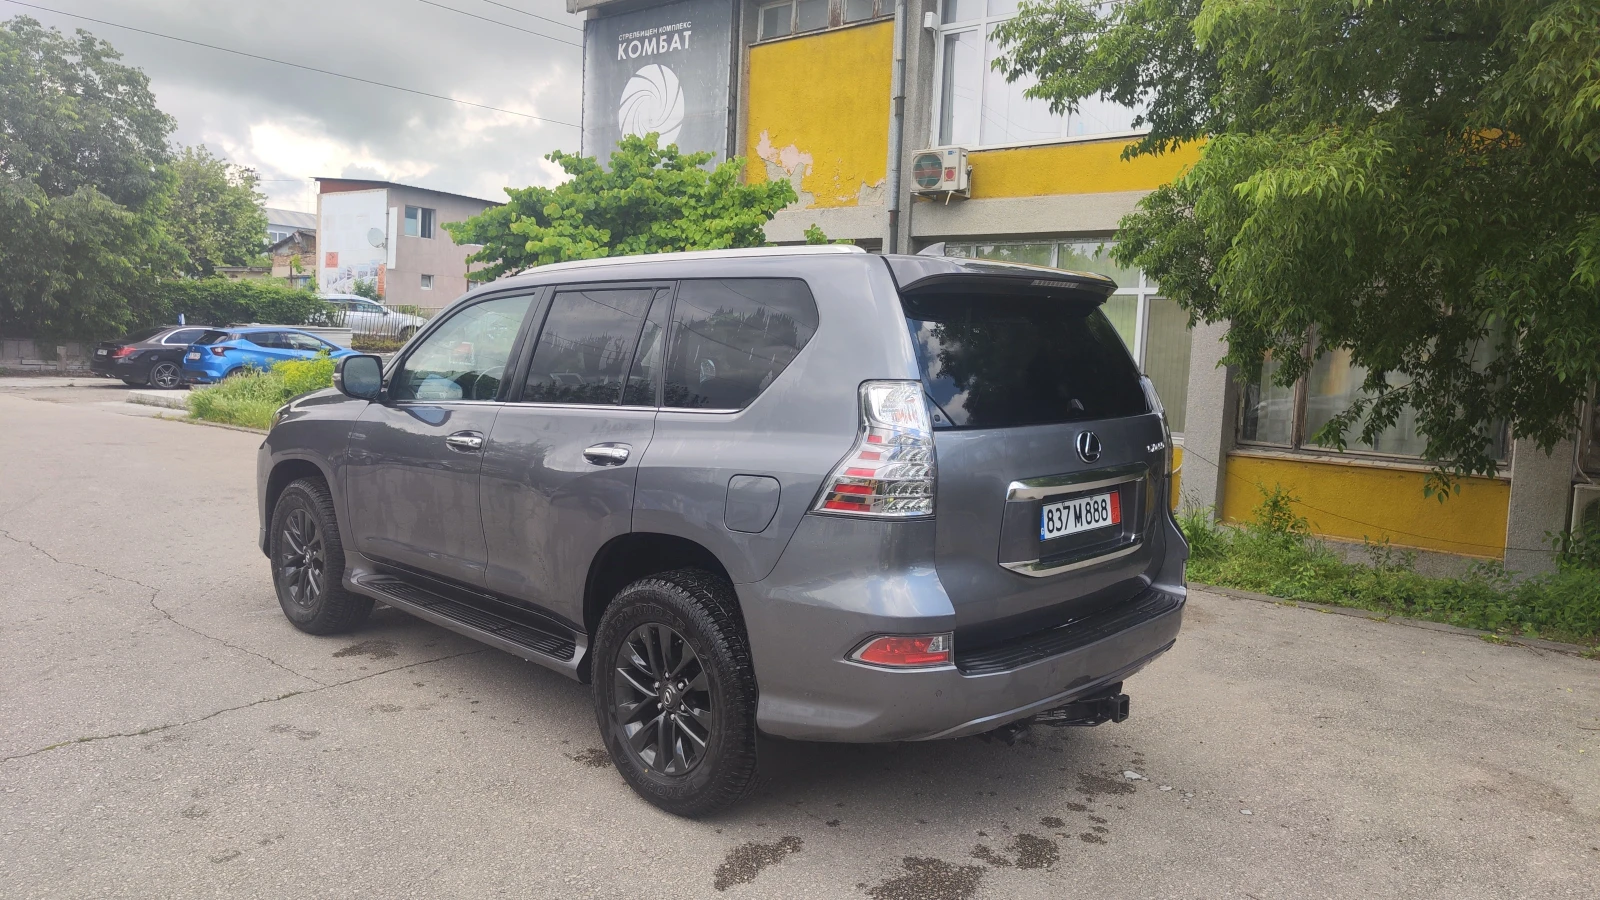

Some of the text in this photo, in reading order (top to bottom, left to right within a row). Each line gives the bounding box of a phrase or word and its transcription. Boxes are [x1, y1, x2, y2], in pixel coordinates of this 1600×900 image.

[618, 21, 692, 41] СТРЕЛБИЩЕН КОМПЛЕКС
[618, 31, 692, 60] КОМБАТ
